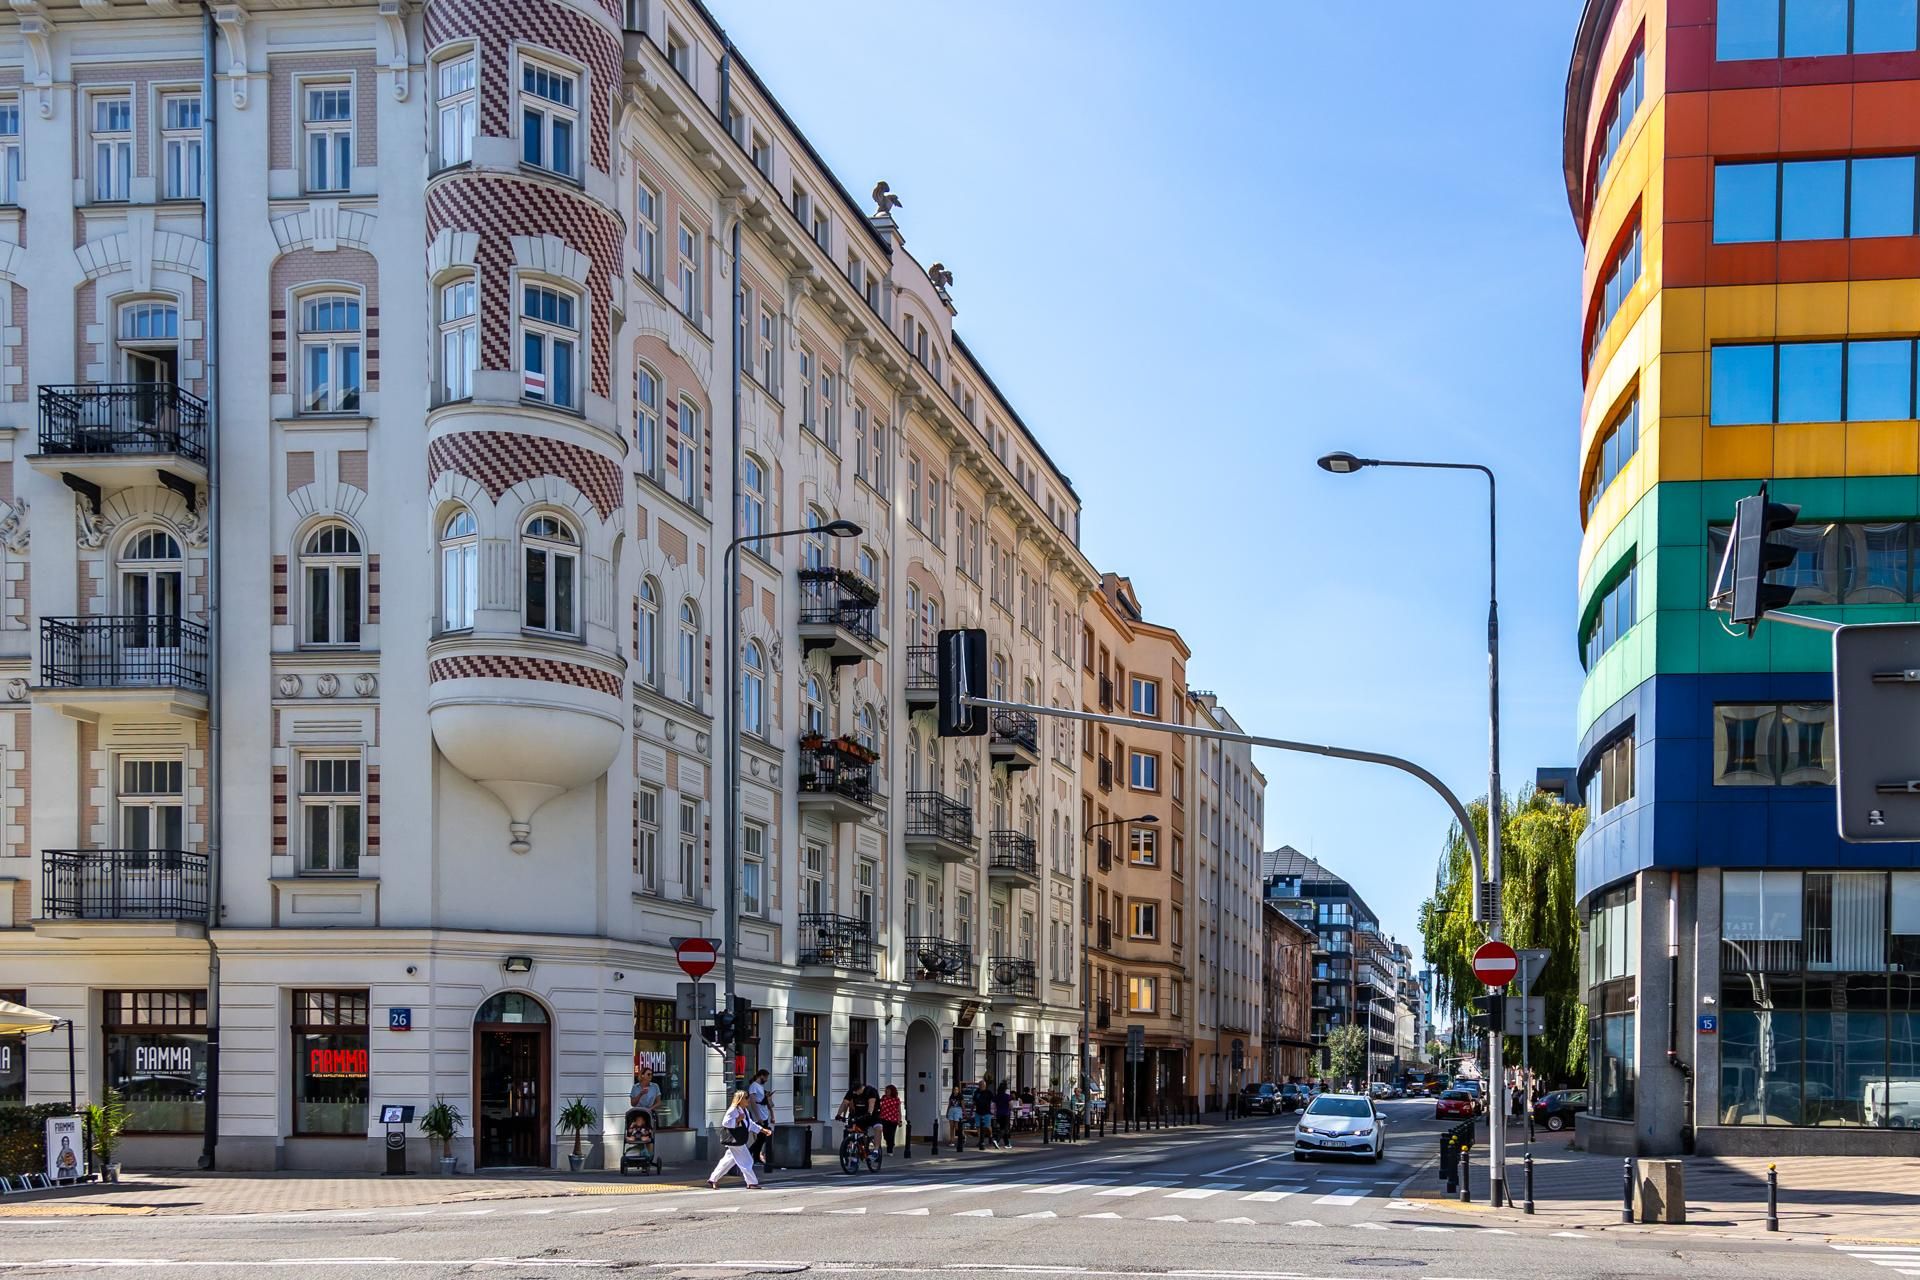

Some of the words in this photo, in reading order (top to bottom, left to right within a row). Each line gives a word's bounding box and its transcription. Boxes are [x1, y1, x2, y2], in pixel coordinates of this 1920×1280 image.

[392, 1014, 407, 1025] 26
[1703, 1019, 1713, 1029] 15
[136, 1046, 191, 1070] FIAMMA
[311, 1049, 367, 1072] FIAMMA
[640, 1051, 666, 1072] FIAMMA
[55, 1121, 75, 1131] FIAMMA
